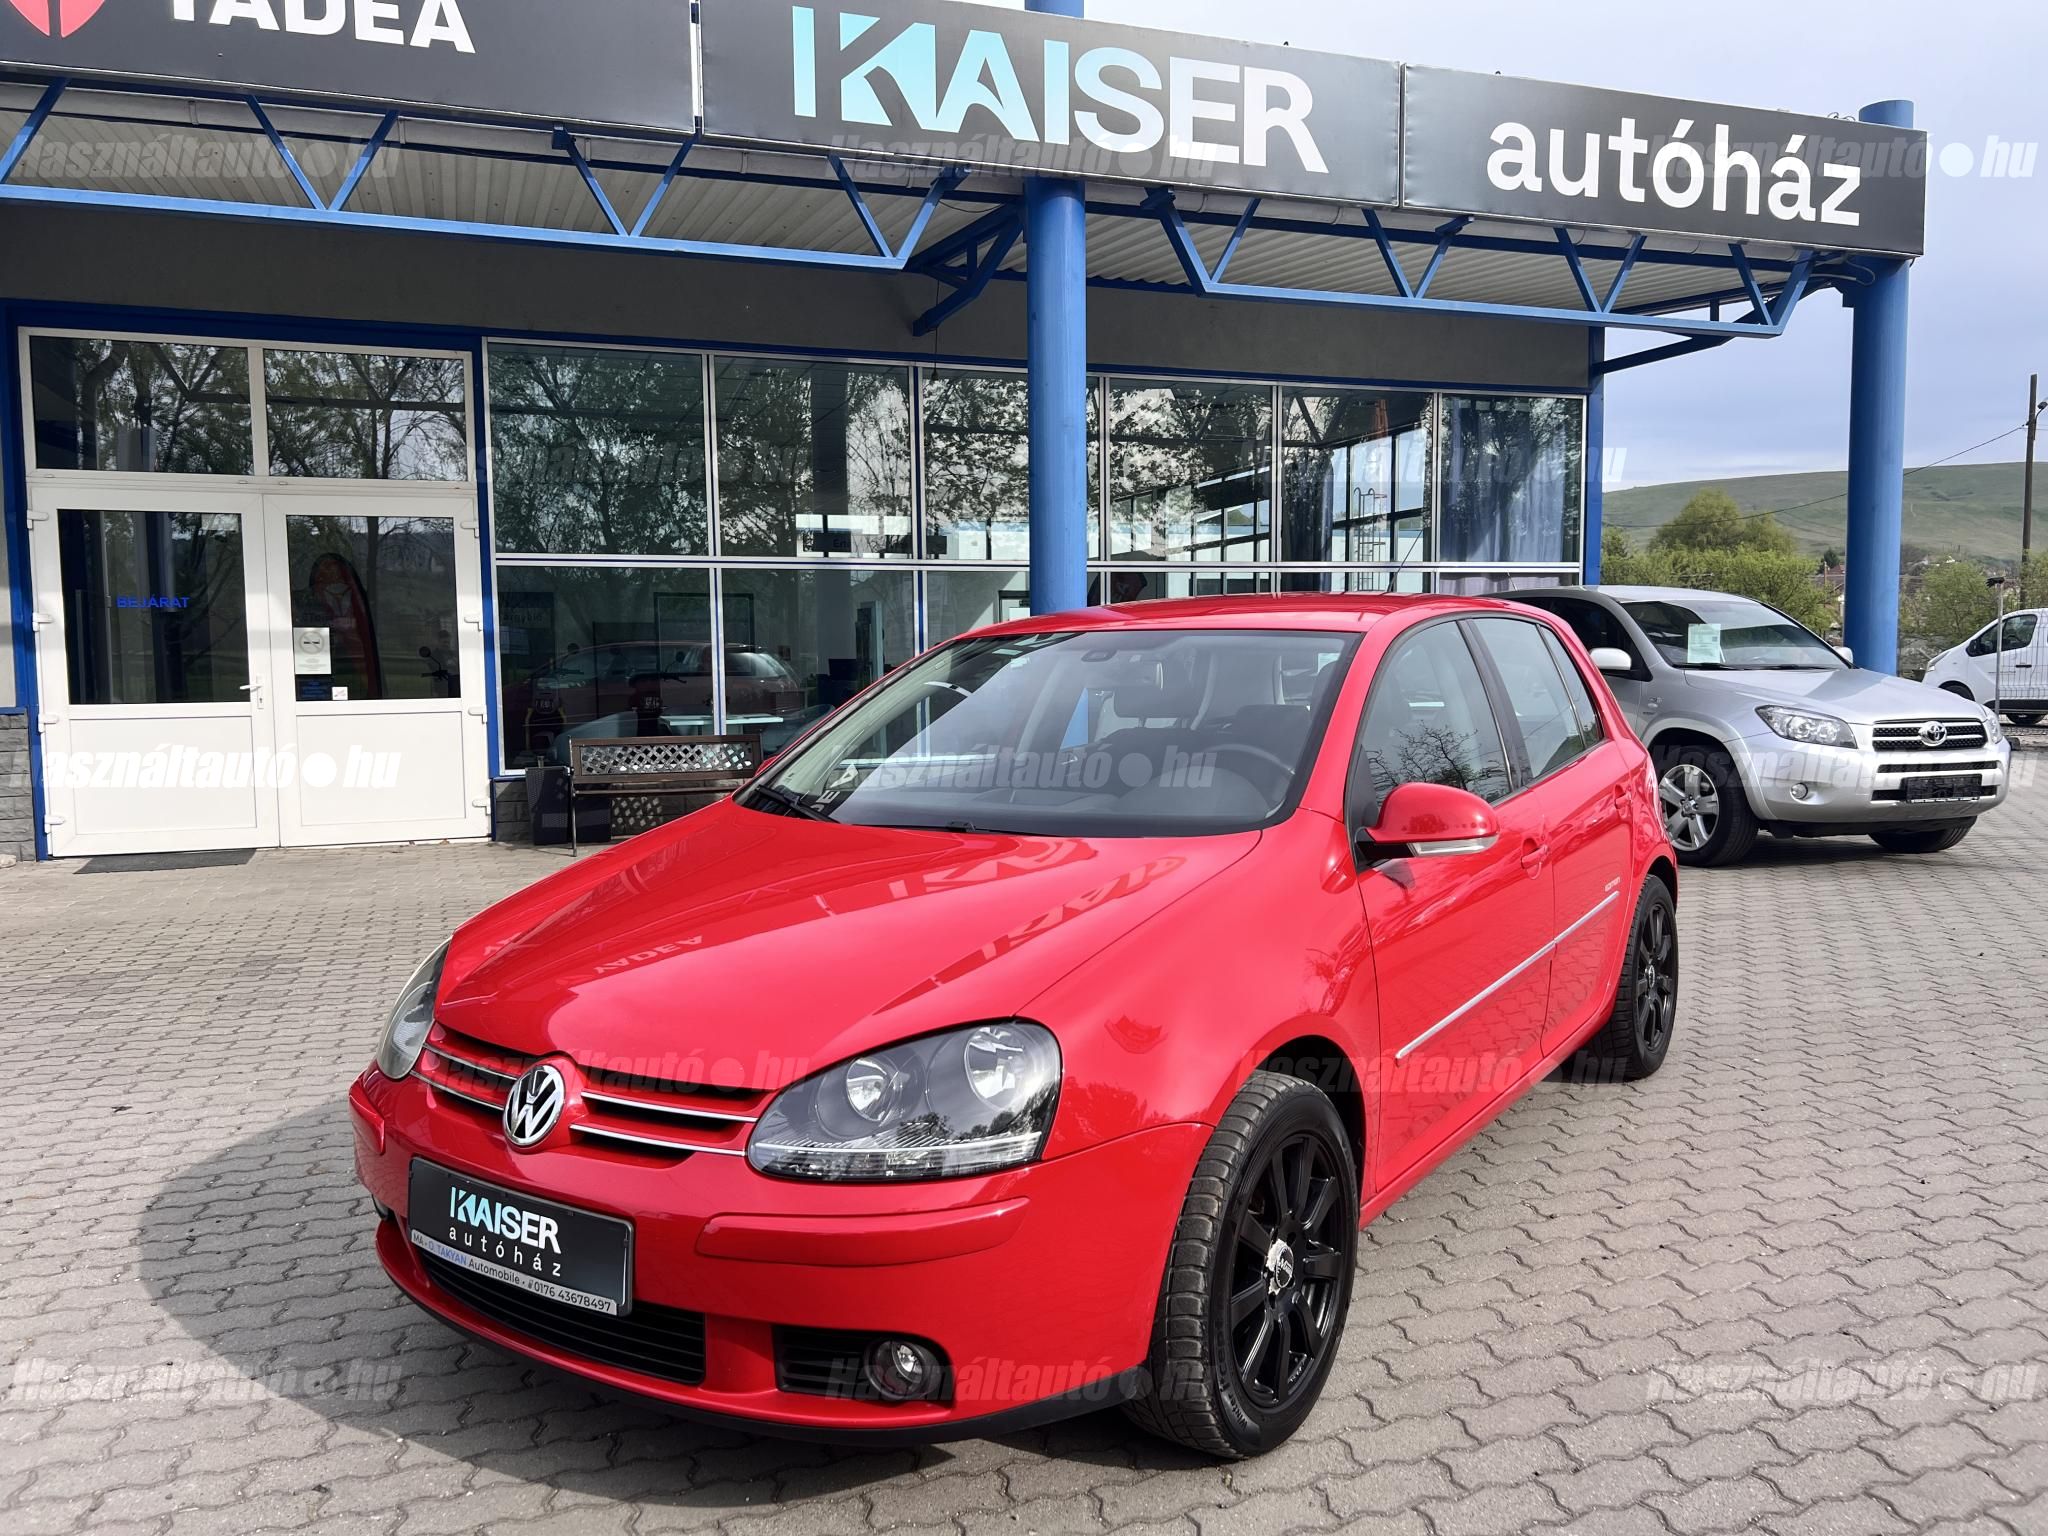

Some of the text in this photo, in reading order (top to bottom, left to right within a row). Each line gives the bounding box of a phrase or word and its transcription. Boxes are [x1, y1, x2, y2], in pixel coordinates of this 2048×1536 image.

[792, 6, 1861, 226] KAISER autóház
[449, 1186, 562, 1255] KAISER
[468, 1258, 520, 1285] Automobile
[534, 1281, 556, 1298] 0176
[558, 1289, 611, 1312] 43678497
